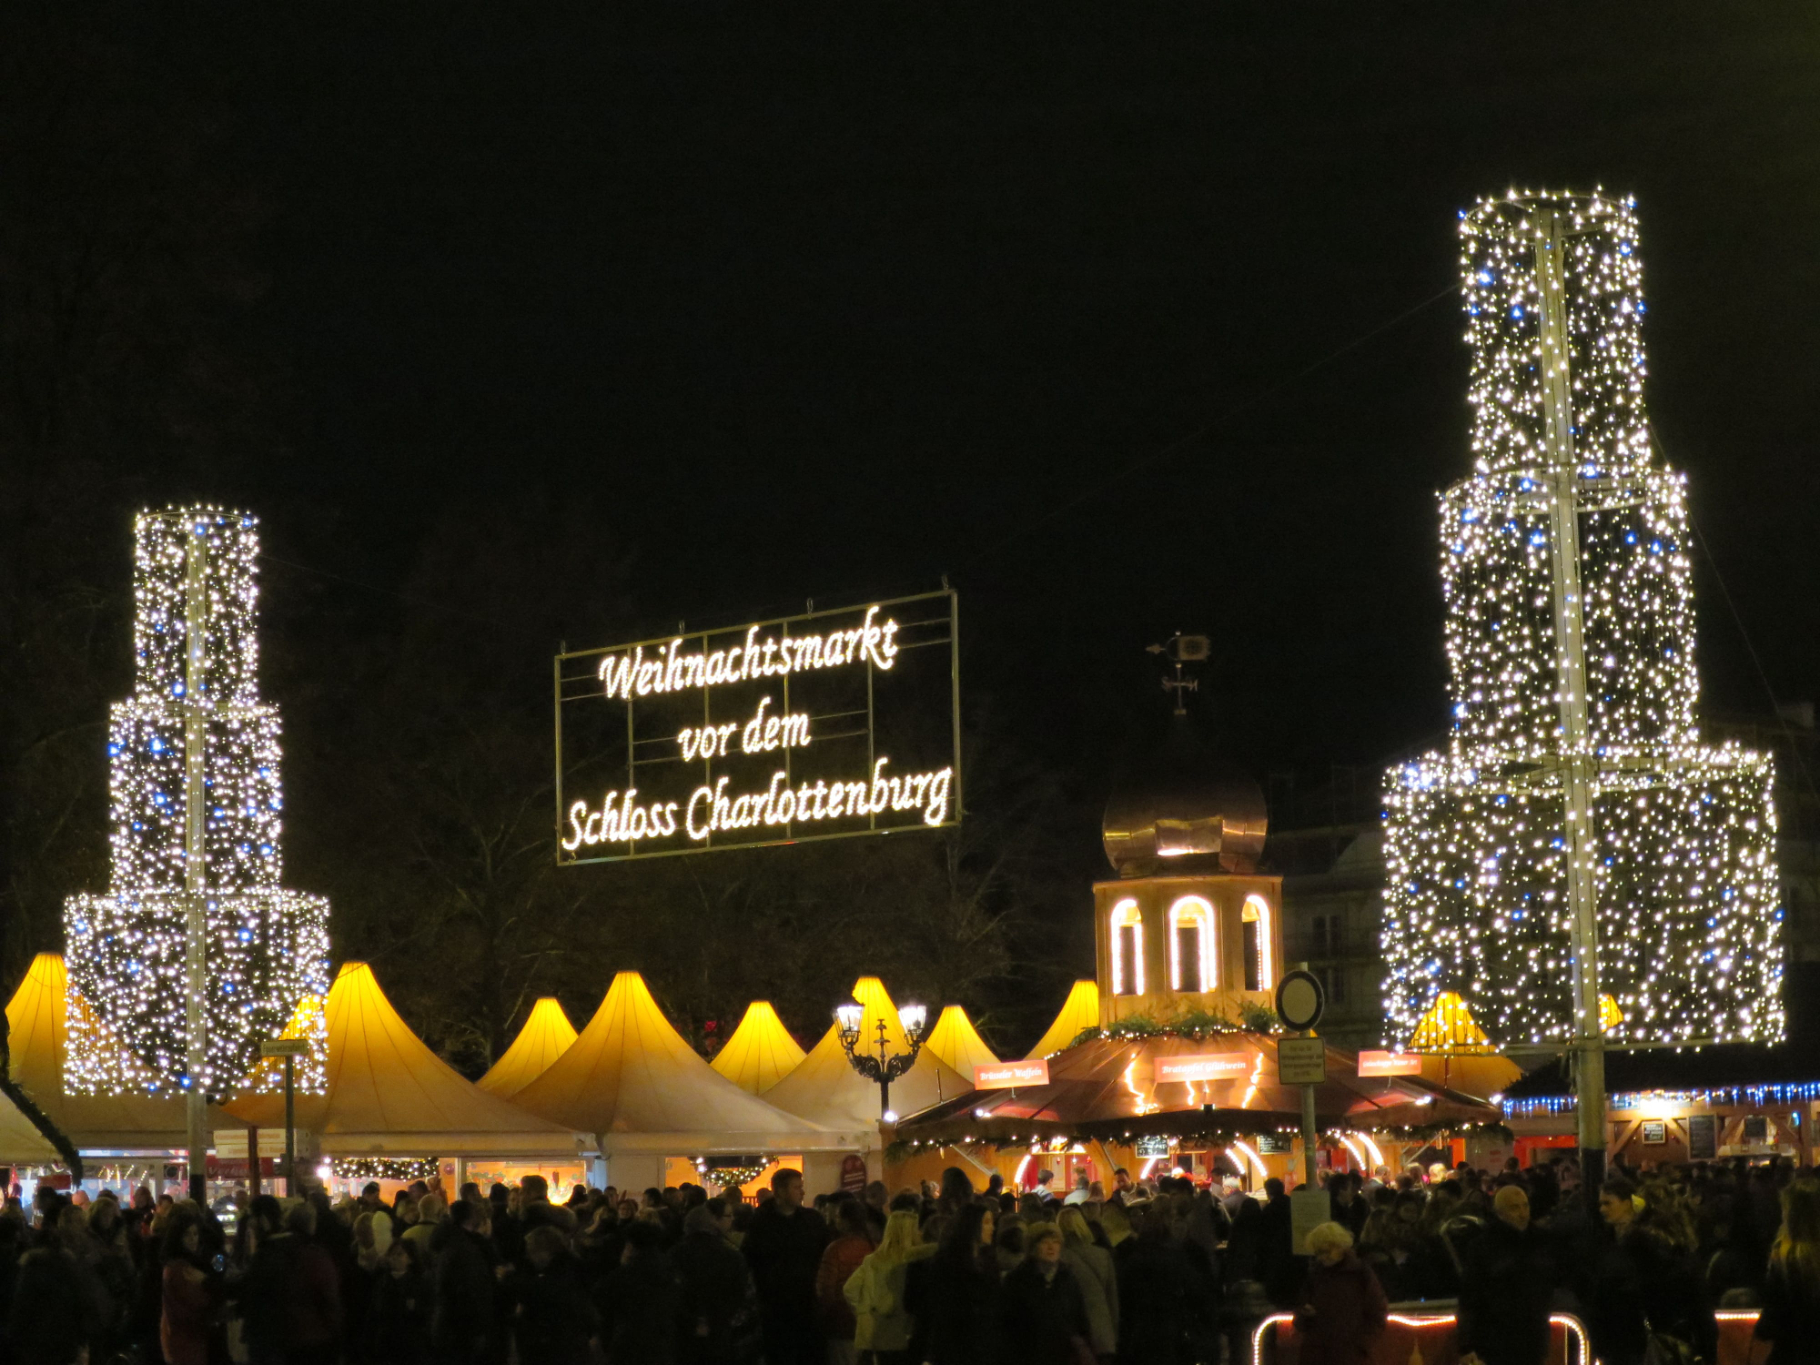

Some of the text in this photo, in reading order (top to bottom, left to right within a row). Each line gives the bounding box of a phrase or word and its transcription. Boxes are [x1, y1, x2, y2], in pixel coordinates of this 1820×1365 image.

[598, 605, 899, 699] Weihnachtsmarkt
[677, 696, 812, 762] vor dem
[561, 758, 953, 852] Schloss Charlottenburg
